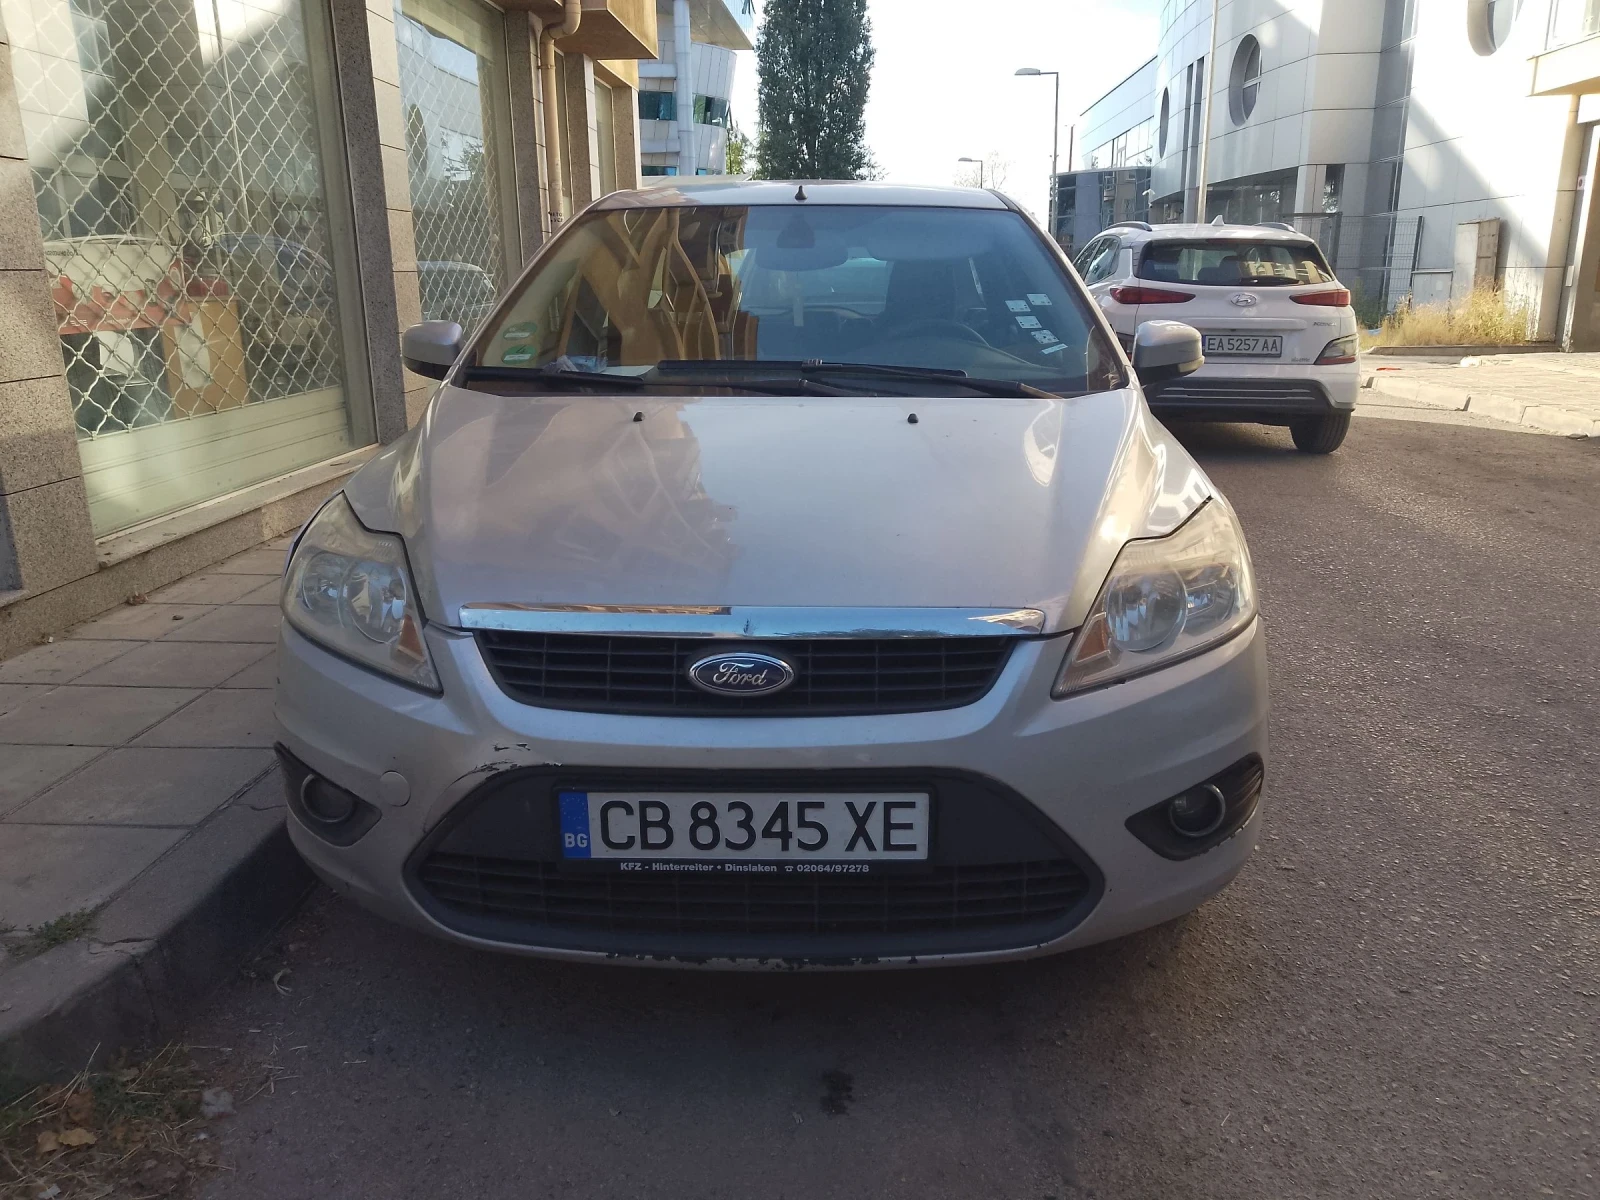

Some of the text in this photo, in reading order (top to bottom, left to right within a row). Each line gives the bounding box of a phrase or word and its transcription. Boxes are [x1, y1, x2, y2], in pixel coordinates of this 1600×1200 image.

[1207, 337, 1279, 352] EA 5257 AA
[713, 661, 768, 686] Ford
[600, 800, 918, 852] CB 8345 XE
[564, 832, 588, 848] BG
[620, 862, 642, 871] KFZ
[652, 862, 714, 871] Hinterreiter
[725, 863, 778, 872] Dinslaken
[796, 864, 870, 873] 02064/97278
